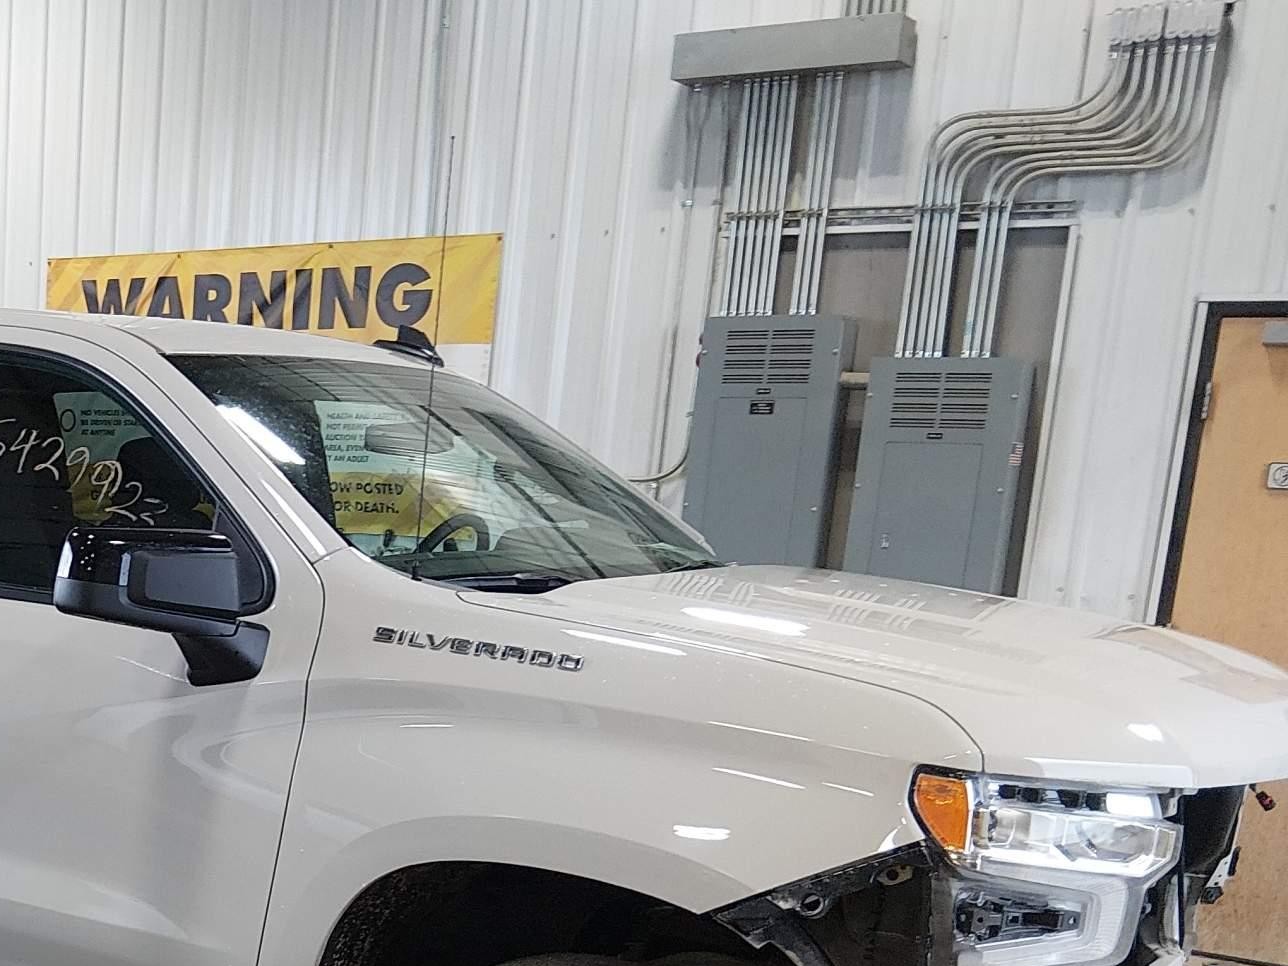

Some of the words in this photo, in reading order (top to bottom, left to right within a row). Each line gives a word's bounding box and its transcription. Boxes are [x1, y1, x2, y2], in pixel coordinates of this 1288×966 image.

[82, 262, 433, 330] WARNING
[329, 481, 352, 493] OW
[356, 481, 404, 496] POSTED
[333, 500, 352, 512] OR
[355, 501, 400, 514] DEATH.
[373, 626, 584, 672] SILVERADO
